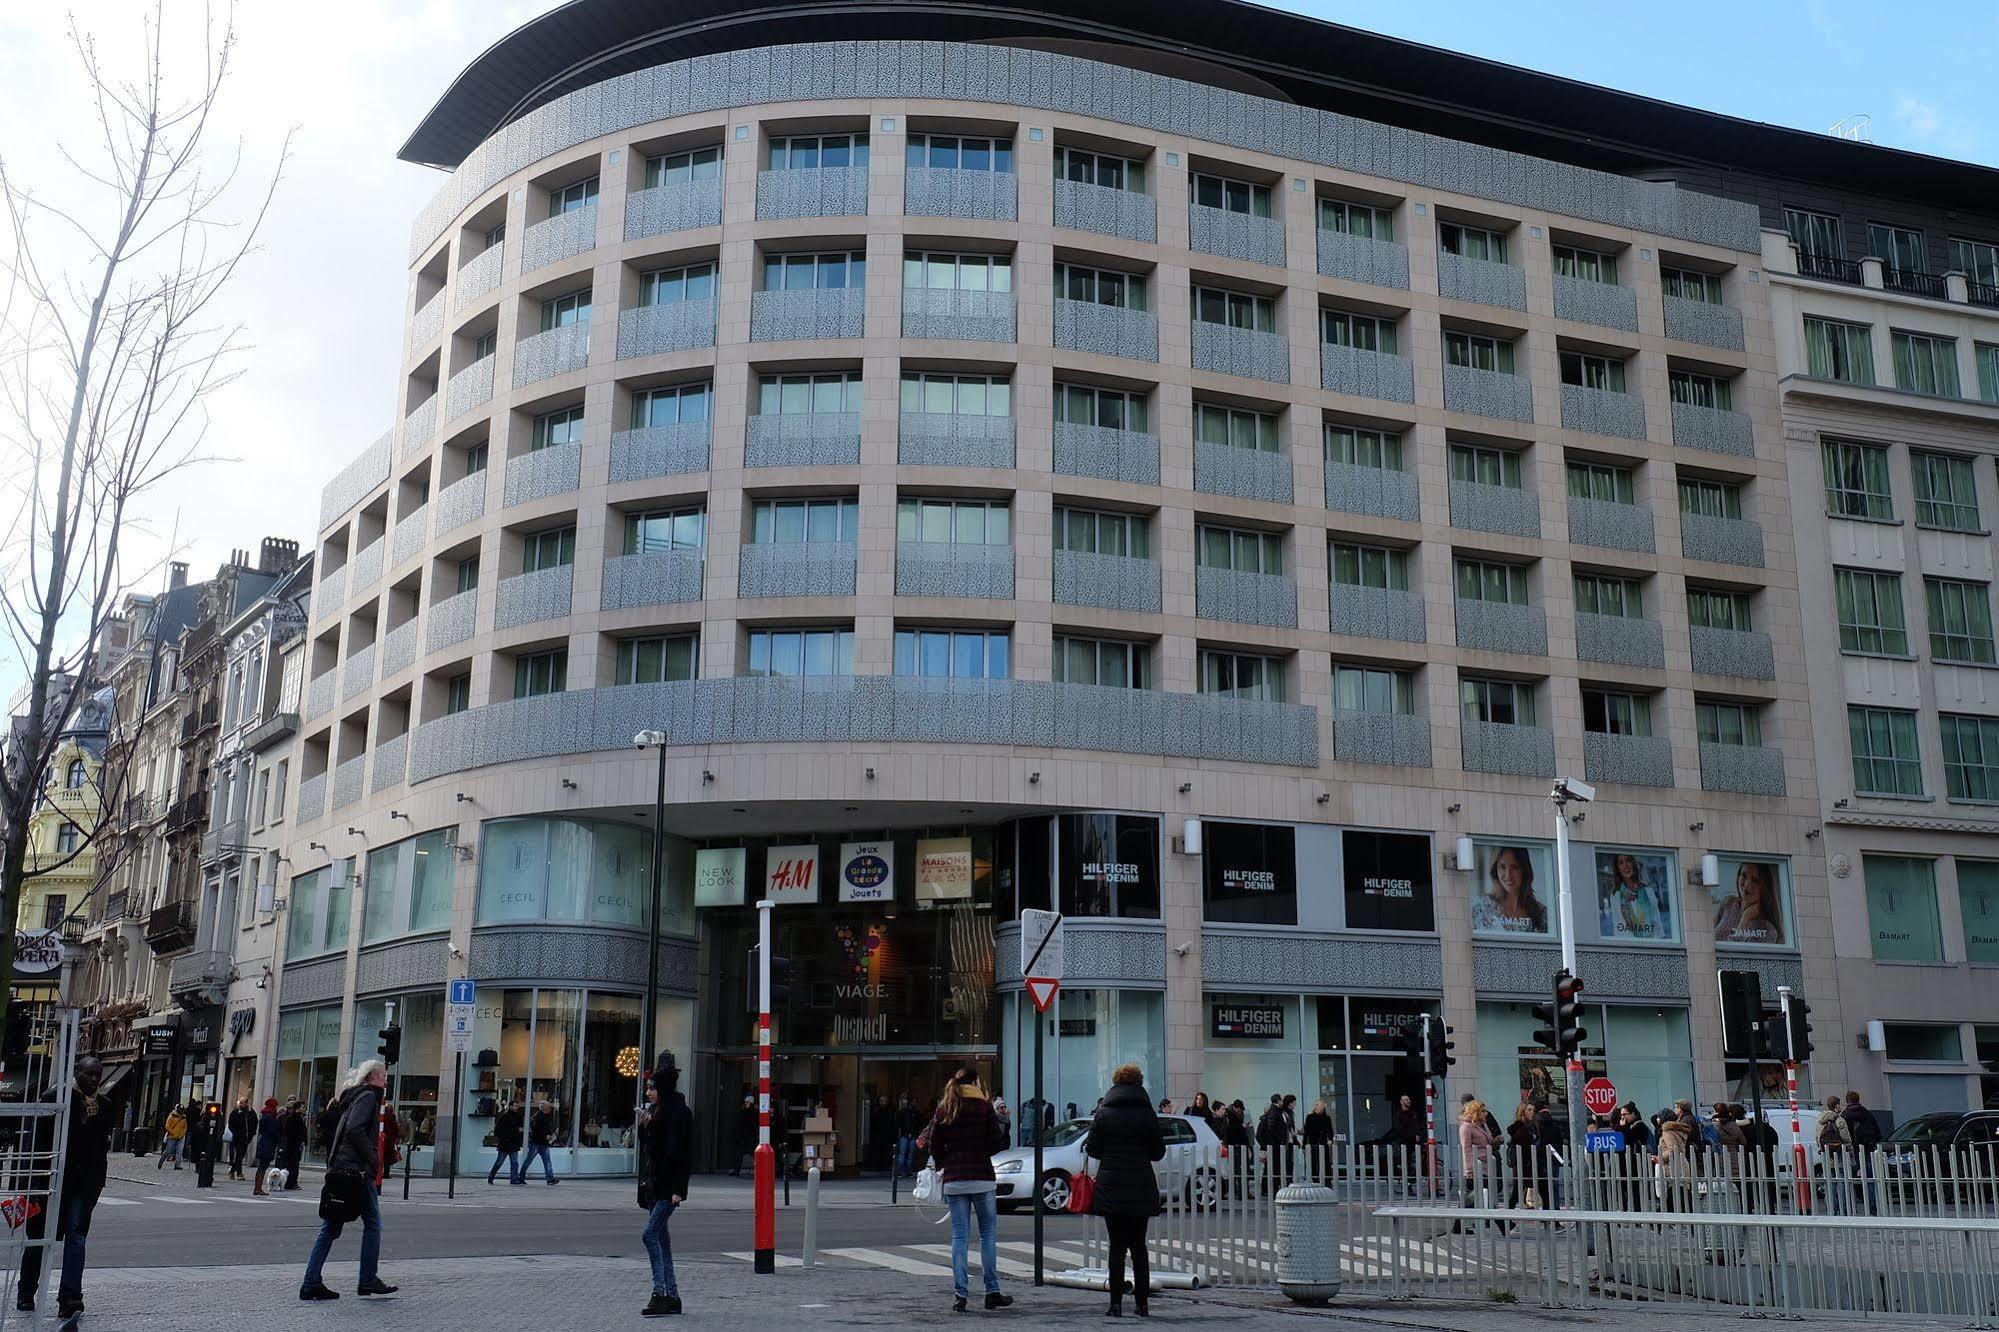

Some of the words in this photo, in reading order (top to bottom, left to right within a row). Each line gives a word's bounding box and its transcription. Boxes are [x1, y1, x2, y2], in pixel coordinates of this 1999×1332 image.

[856, 845, 879, 855] Jeux
[922, 857, 967, 867] MAISONS
[702, 867, 733, 878] NEW
[1082, 863, 1139, 874] HILFIGER
[771, 858, 814, 891] H&M
[1106, 873, 1140, 883] DENIM
[1223, 870, 1274, 881] HILFIGER
[699, 877, 735, 887] LOOK
[1244, 881, 1275, 891] DENIM
[1364, 878, 1412, 889] HILFIGER
[500, 892, 535, 903] CECIL
[850, 888, 882, 899] Jouets
[1383, 888, 1413, 898] DENIM
[597, 896, 633, 908] CECIL
[1971, 935, 1999, 945] DAMAR
[1218, 1009, 1282, 1024] HILFIGER
[150, 1029, 174, 1037] LUSH
[1244, 1023, 1282, 1035] DENIM
[1586, 1088, 1615, 1104] STOP
[1593, 1136, 1617, 1149] BUS
